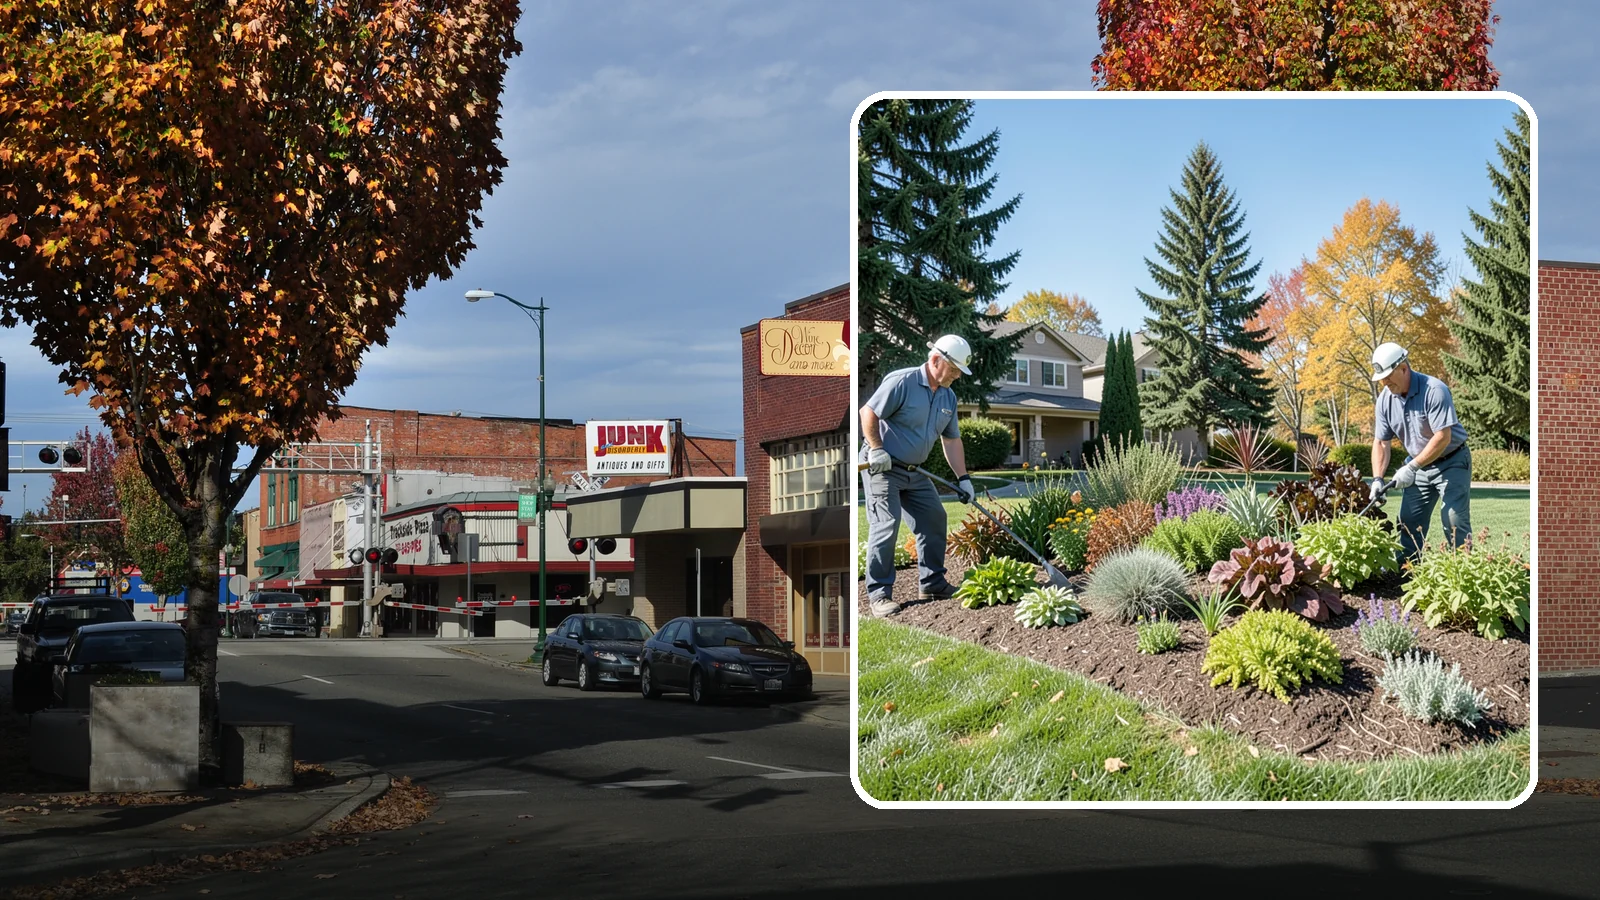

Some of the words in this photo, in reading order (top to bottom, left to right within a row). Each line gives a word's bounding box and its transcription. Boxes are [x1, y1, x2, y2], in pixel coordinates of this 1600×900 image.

[595, 425, 664, 457] JUNK
[607, 446, 646, 454] DISORDERLY
[596, 461, 628, 470] ANTIQUES
[631, 461, 644, 470] AND
[646, 460, 666, 469] GIFTS
[573, 473, 589, 493] RAIL
[390, 523, 413, 539] Trackside
[414, 519, 429, 535] Pizza
